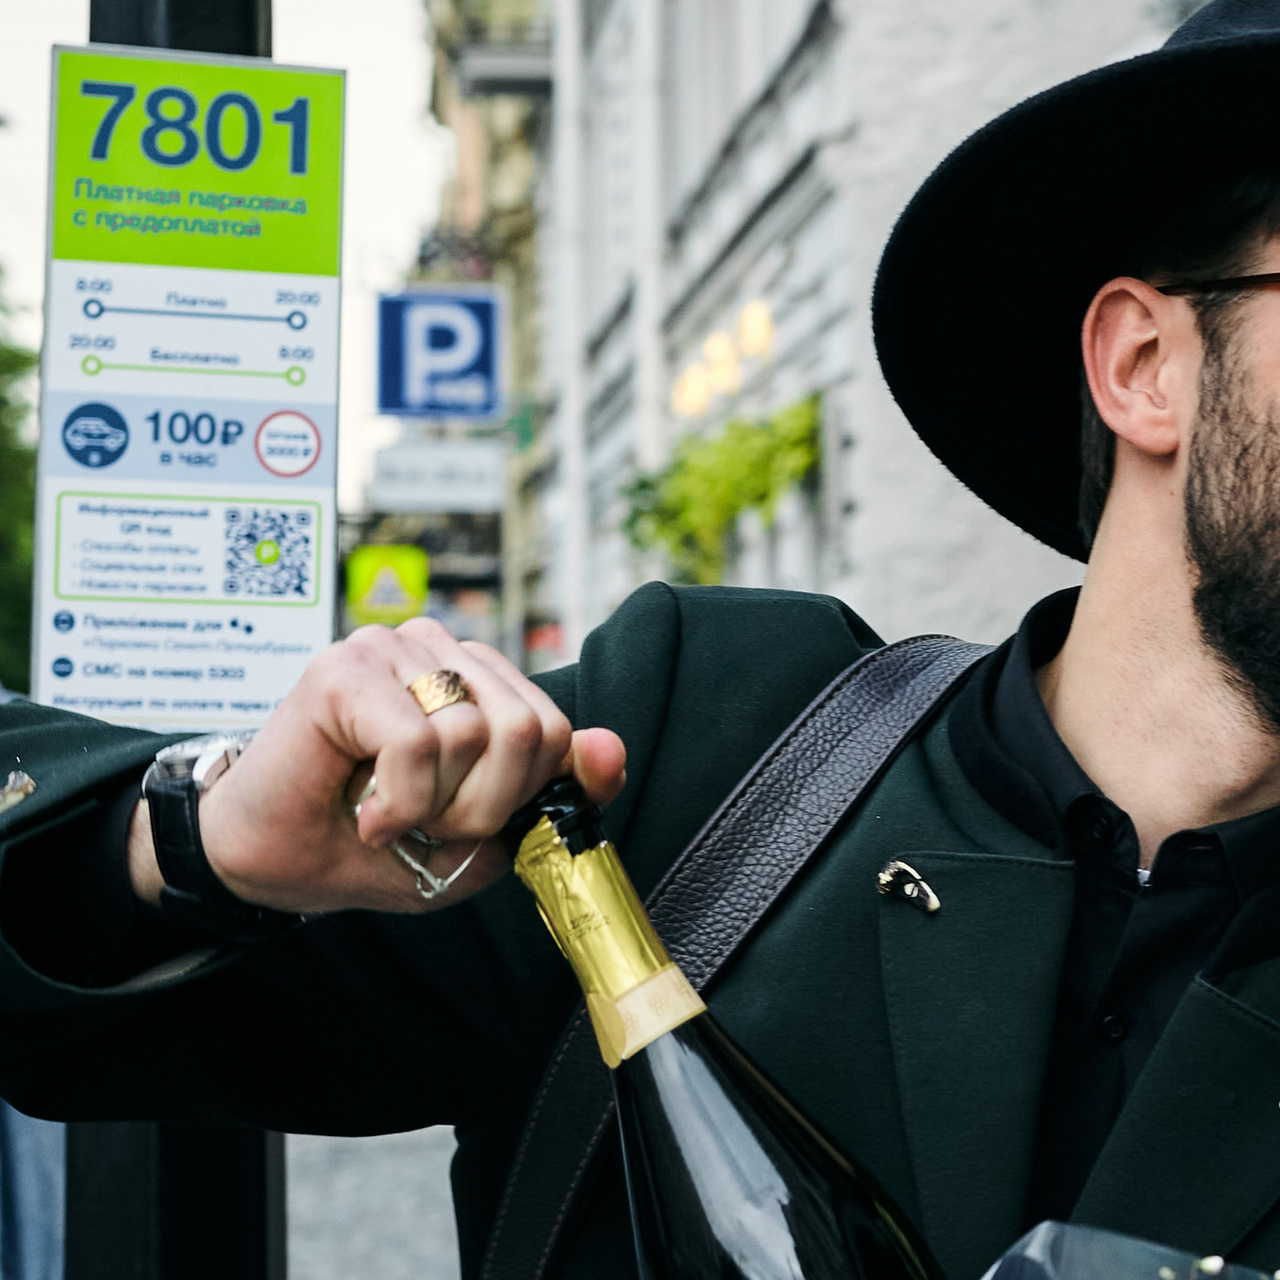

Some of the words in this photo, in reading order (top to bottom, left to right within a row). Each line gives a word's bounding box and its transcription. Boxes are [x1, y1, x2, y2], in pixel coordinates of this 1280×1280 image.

[80, 79, 311, 176] 7801
[74, 177, 181, 204] Платная
[188, 190, 308, 216] парковка
[72, 209, 88, 227] с
[95, 210, 262, 238] предоплатой
[166, 291, 227, 309] Платно
[275, 290, 321, 306] 20:00
[69, 334, 116, 350] 20:00
[403, 303, 483, 404] P
[150, 348, 241, 366] Бесплатно
